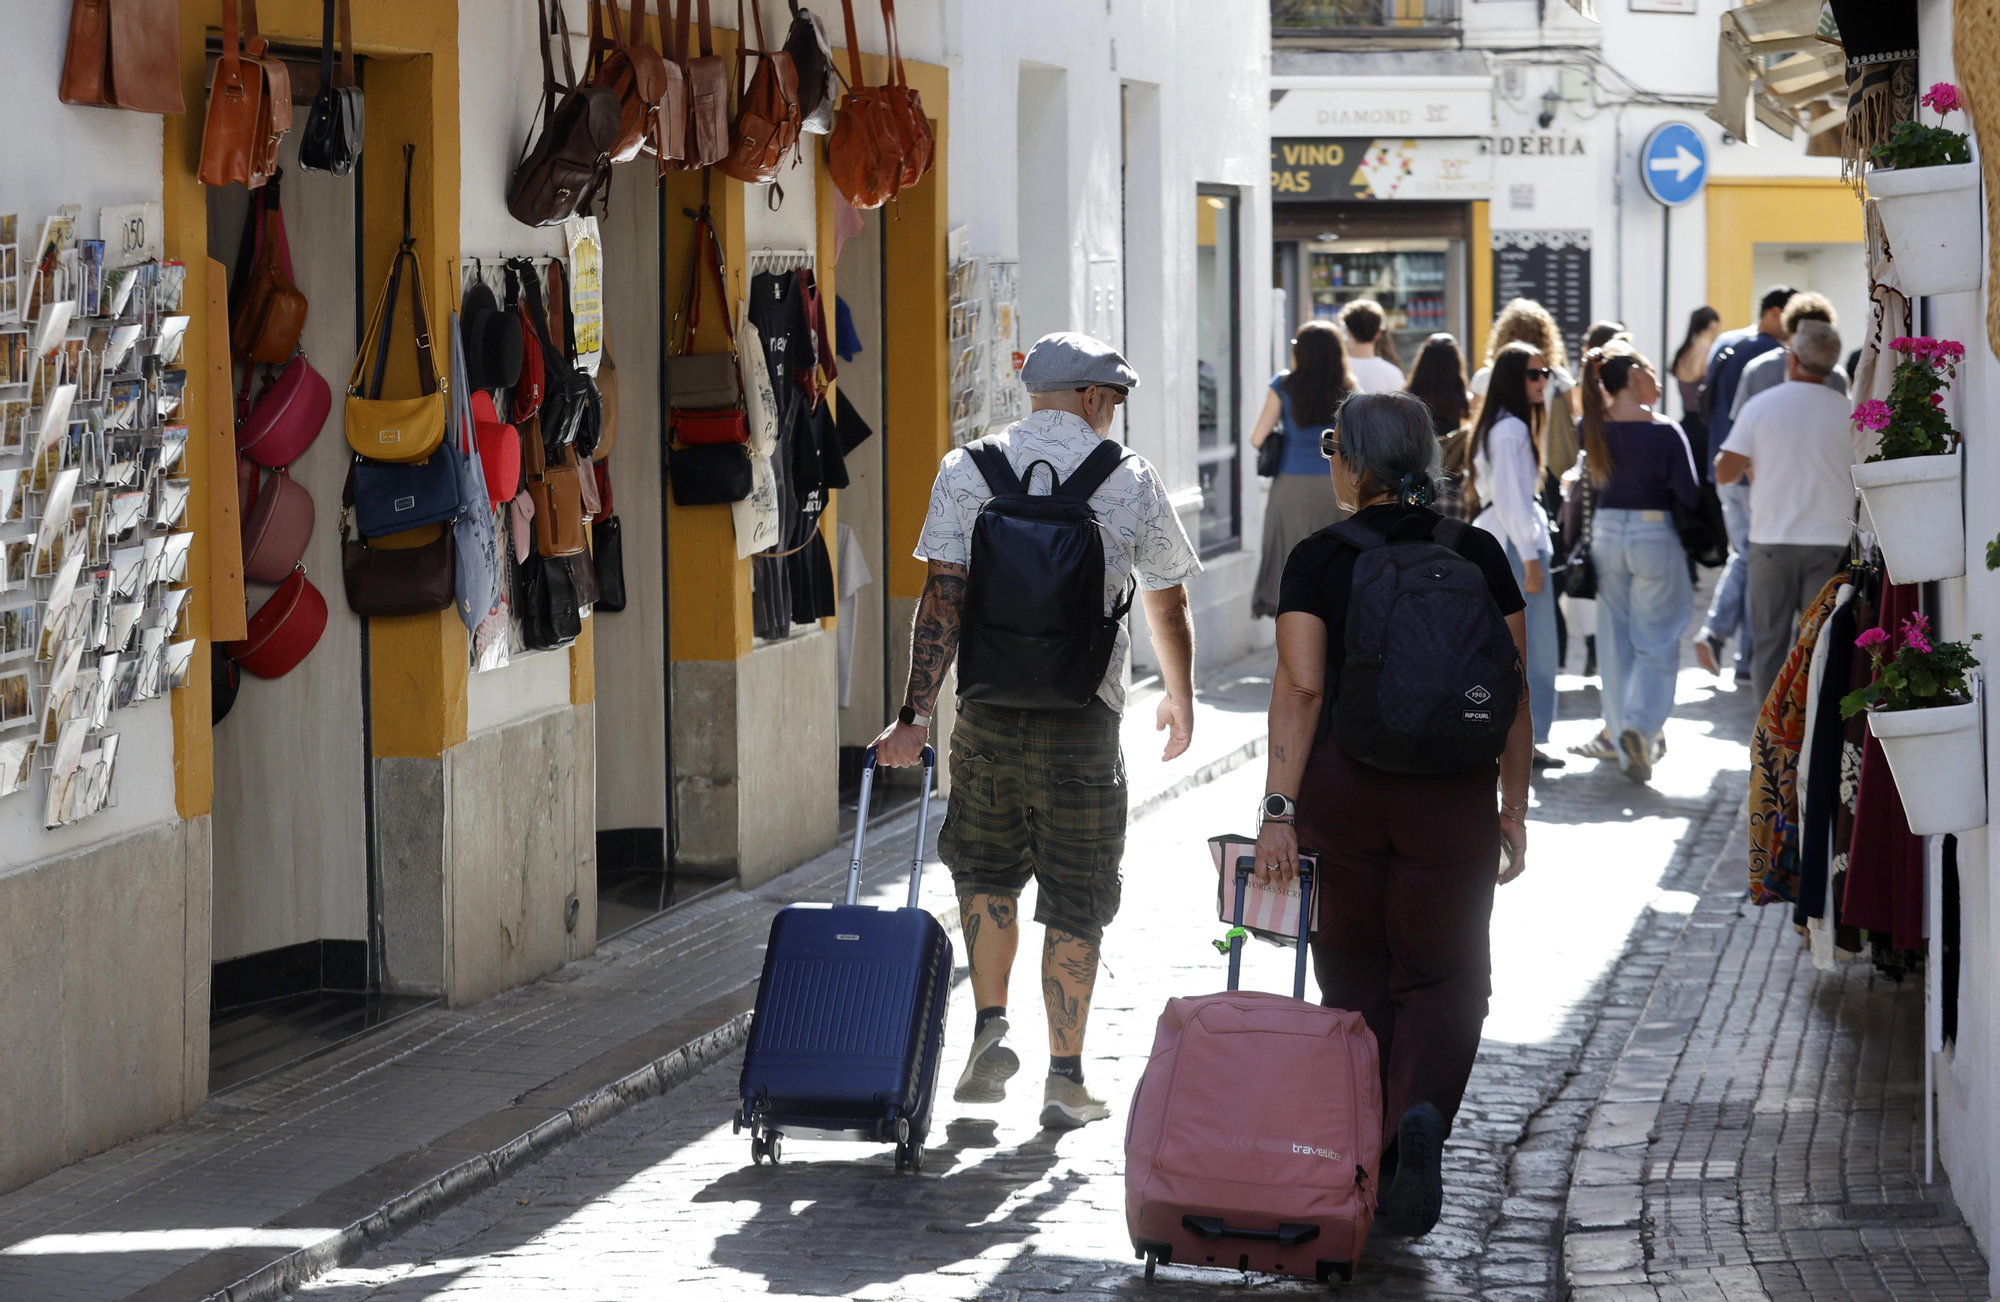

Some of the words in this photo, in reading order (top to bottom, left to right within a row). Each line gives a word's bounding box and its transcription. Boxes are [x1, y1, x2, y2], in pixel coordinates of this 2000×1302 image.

[1316, 110, 1412, 124] DIAMOND
[1282, 144, 1344, 166] VINO
[1490, 136, 1586, 155] DERIA
[1231, 879, 1277, 894] VTORIA'S
[1277, 886, 1302, 899] SECRE
[1292, 1142, 1342, 1161] travelite
